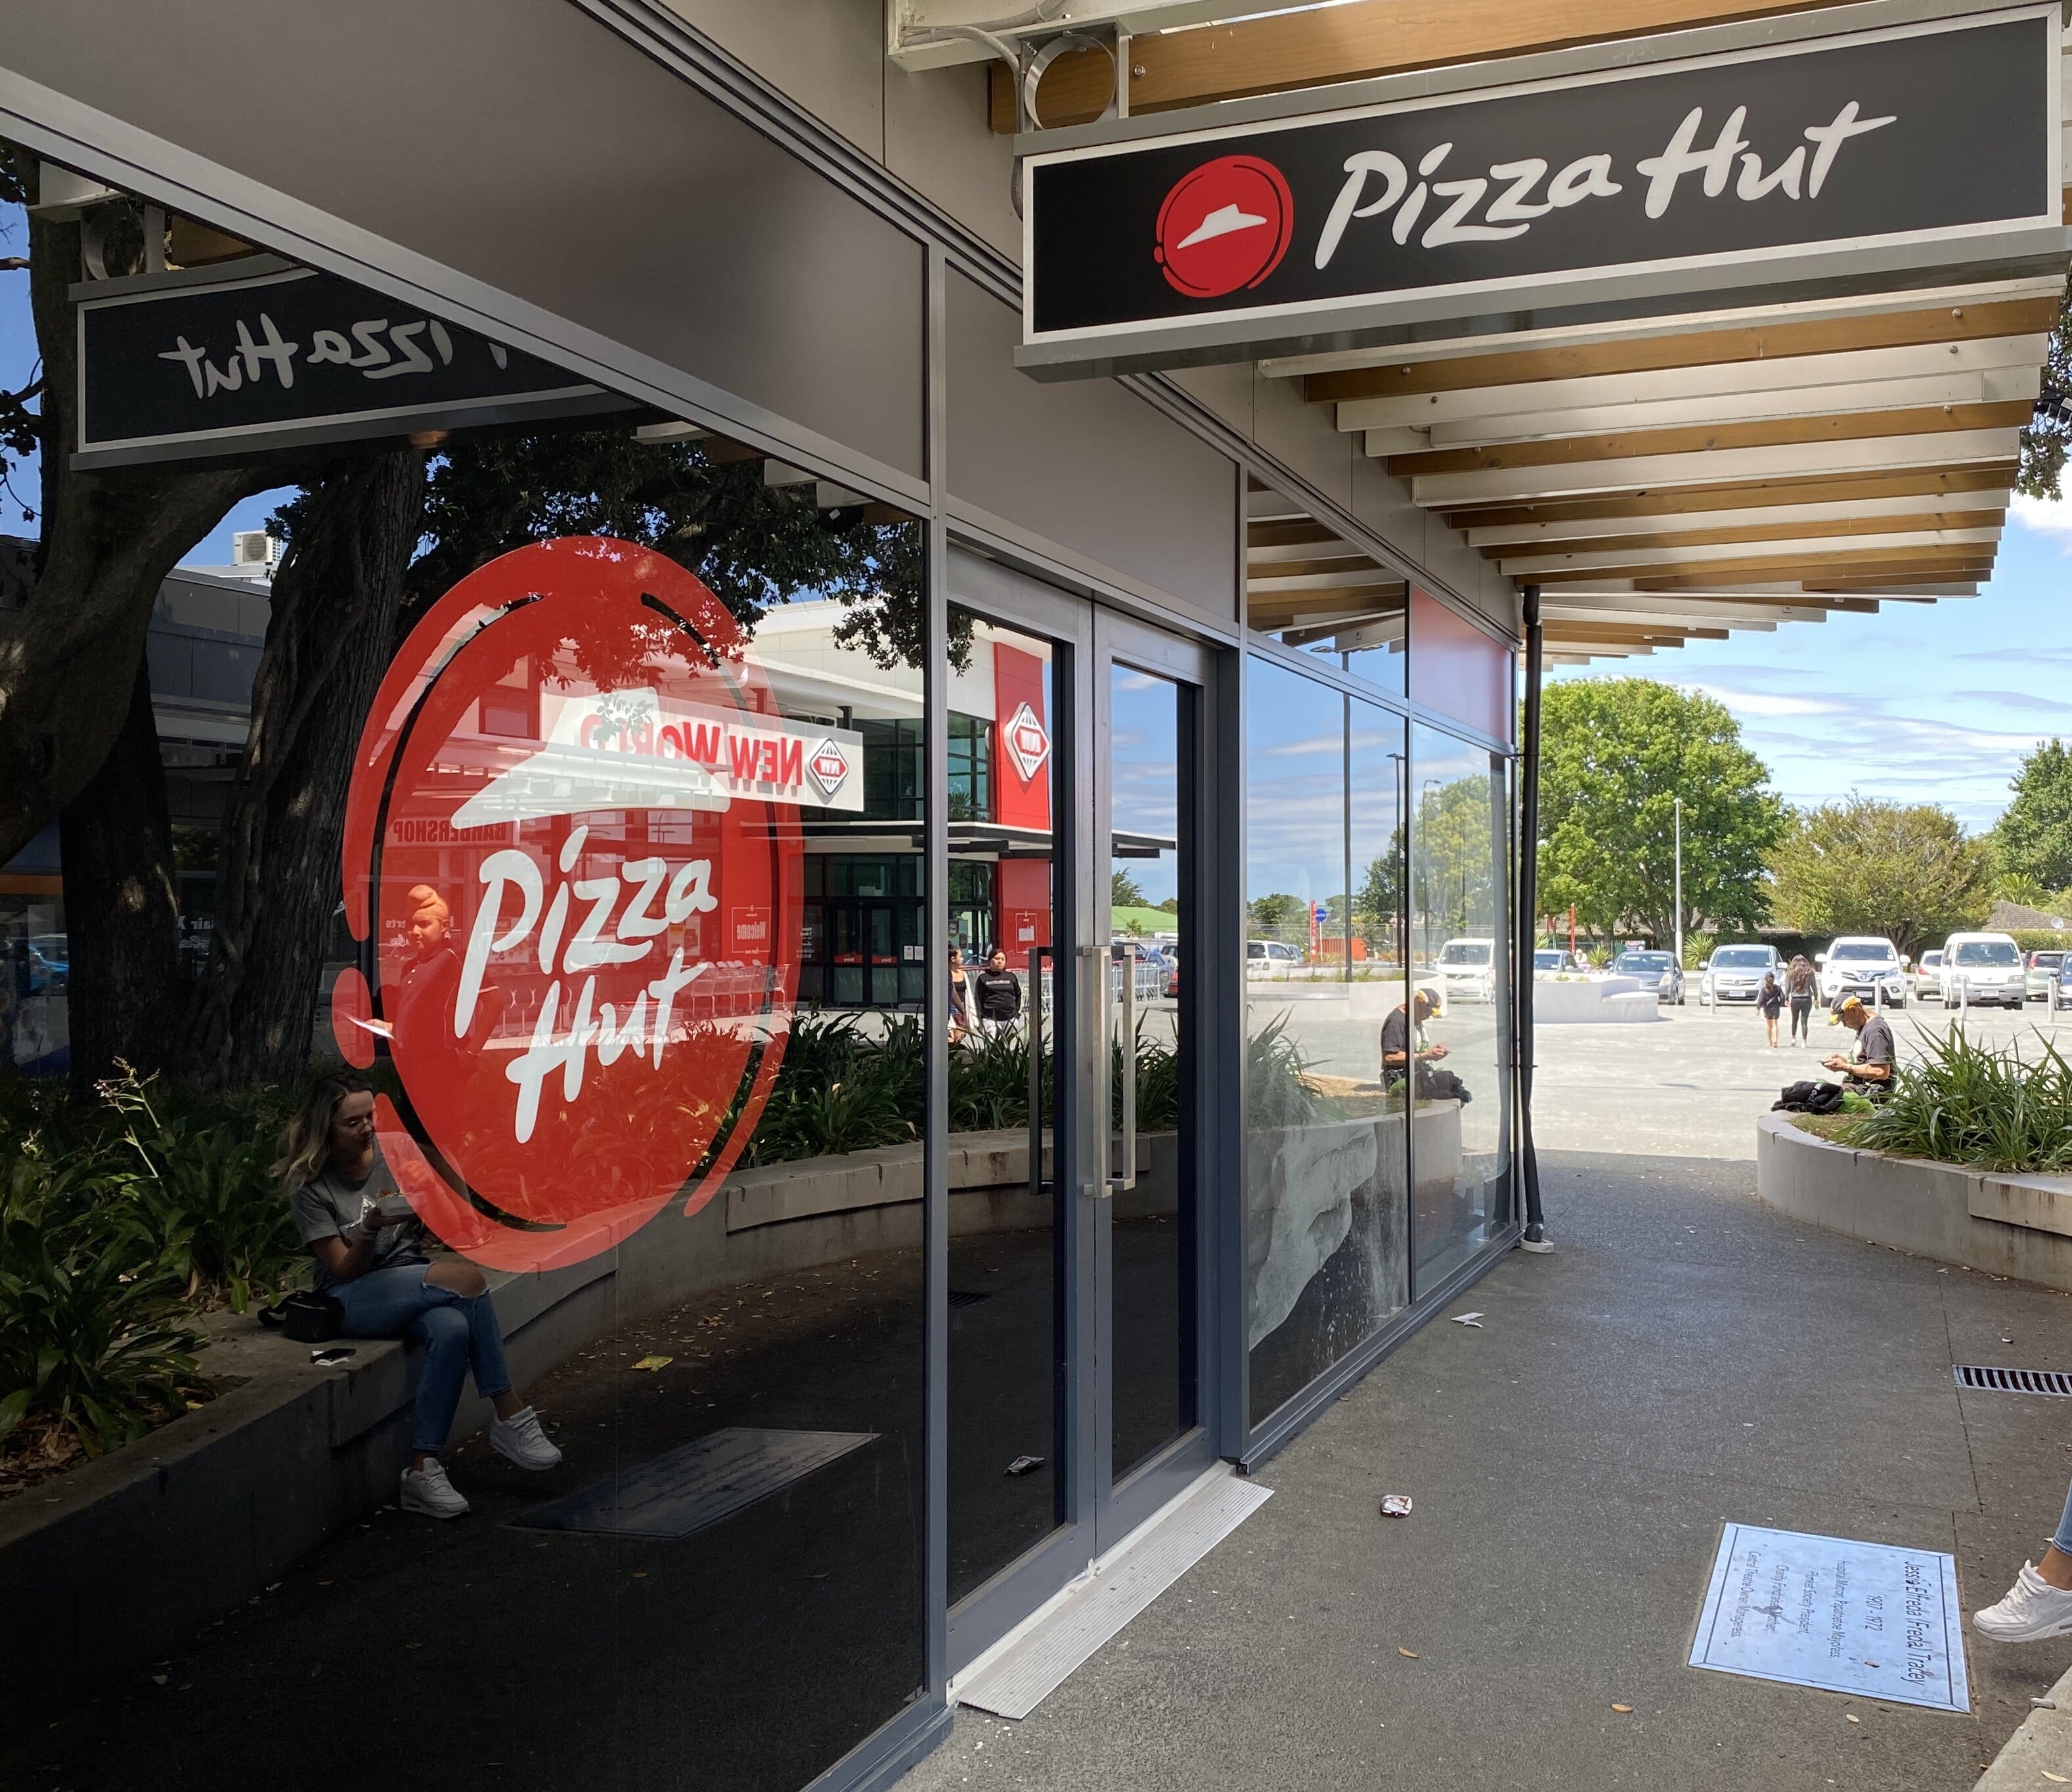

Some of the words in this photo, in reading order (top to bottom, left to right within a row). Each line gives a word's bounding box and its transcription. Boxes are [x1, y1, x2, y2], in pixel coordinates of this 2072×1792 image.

[1314, 142, 1623, 270] Pizza
[1636, 101, 1897, 219] Hut
[454, 824, 718, 1038] Pizza
[505, 947, 709, 1144] Hut
[1746, 1550, 1761, 1569] Central
[1905, 1561, 1926, 1584] Jessie
[1741, 1568, 1760, 1586] Theatre
[1770, 1565, 1790, 1582] Charity
[1797, 1588, 1817, 1608] Society
[1866, 1594, 1884, 1611] 1907
[1905, 1586, 1931, 1617] Elfreda
[1829, 1600, 1848, 1630] Papatoetoe
[1864, 1615, 1884, 1632] 1972
[1905, 1618, 1933, 1651] (Freda)
[1900, 1653, 1931, 1686] Tracey
